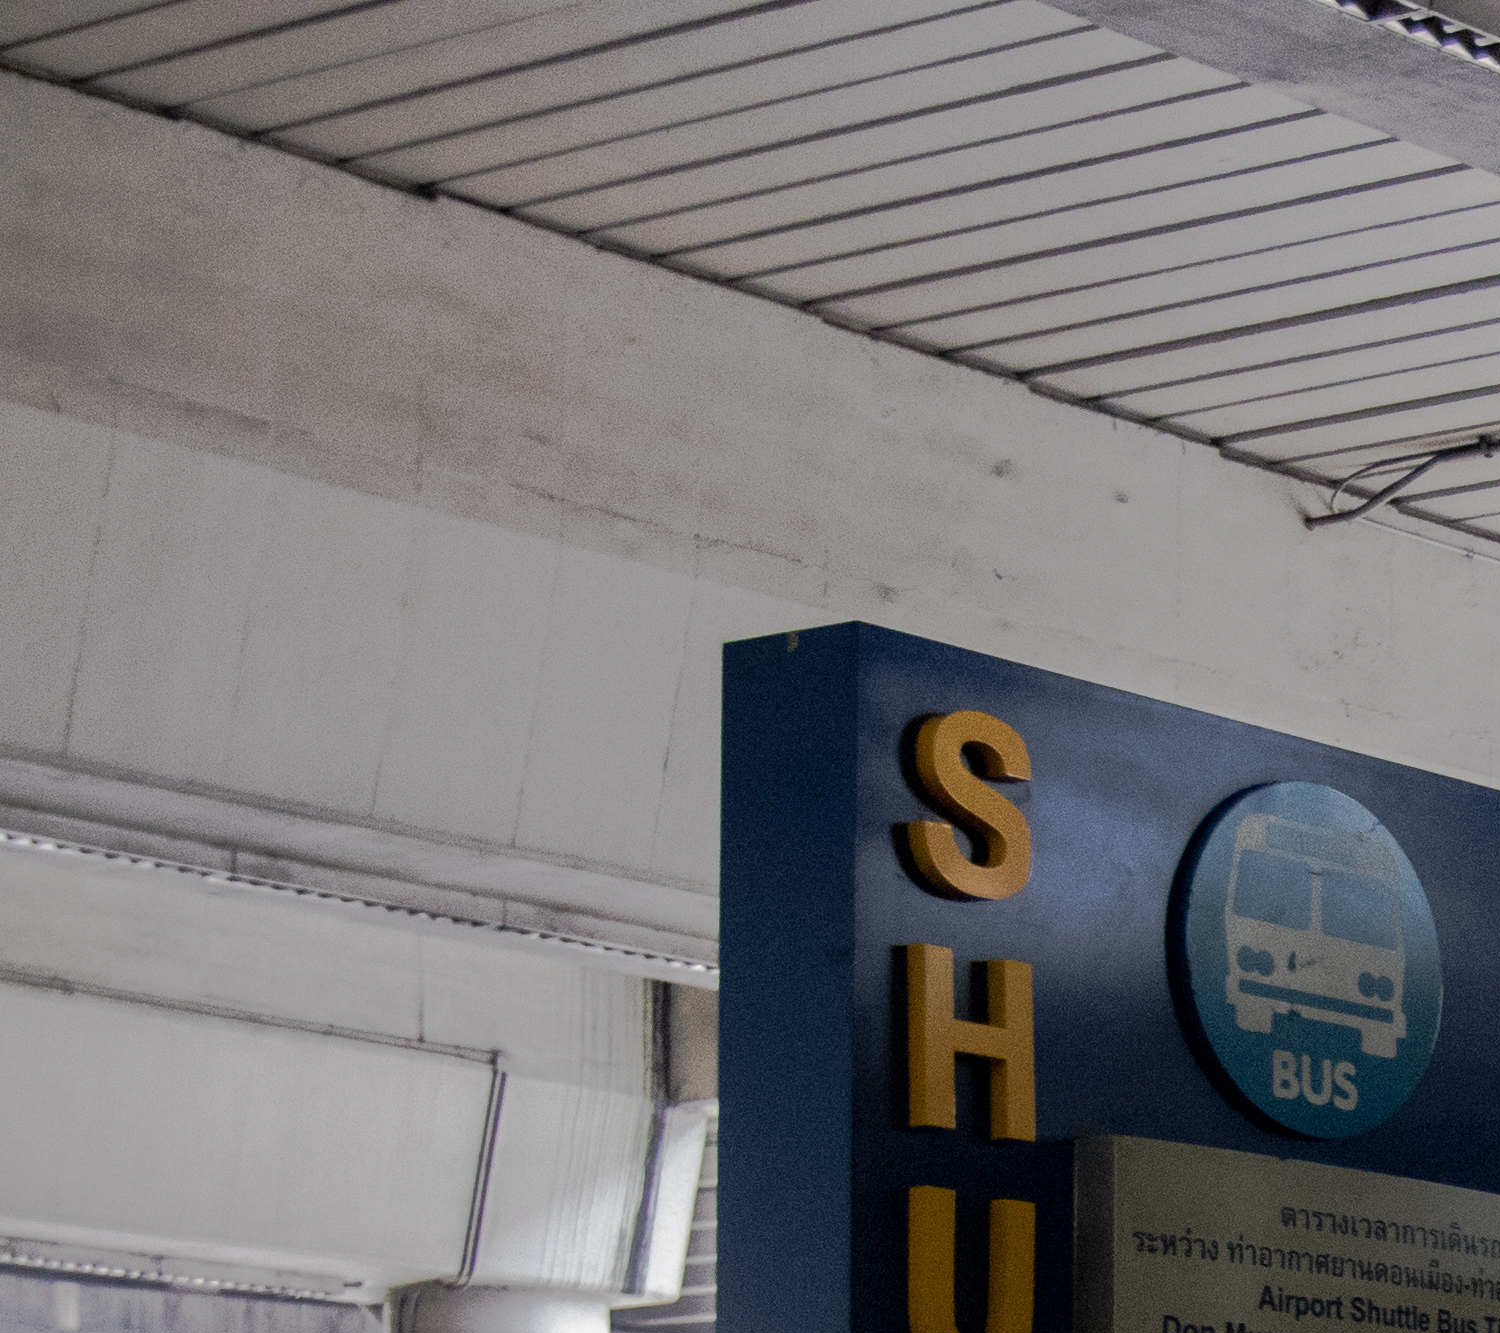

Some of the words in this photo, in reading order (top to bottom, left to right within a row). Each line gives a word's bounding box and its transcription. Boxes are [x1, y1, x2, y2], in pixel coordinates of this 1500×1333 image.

[1272, 1050, 1360, 1111] BUS
[1258, 1285, 1343, 1320] Airport
[1350, 1297, 1430, 1332] Shuttle
